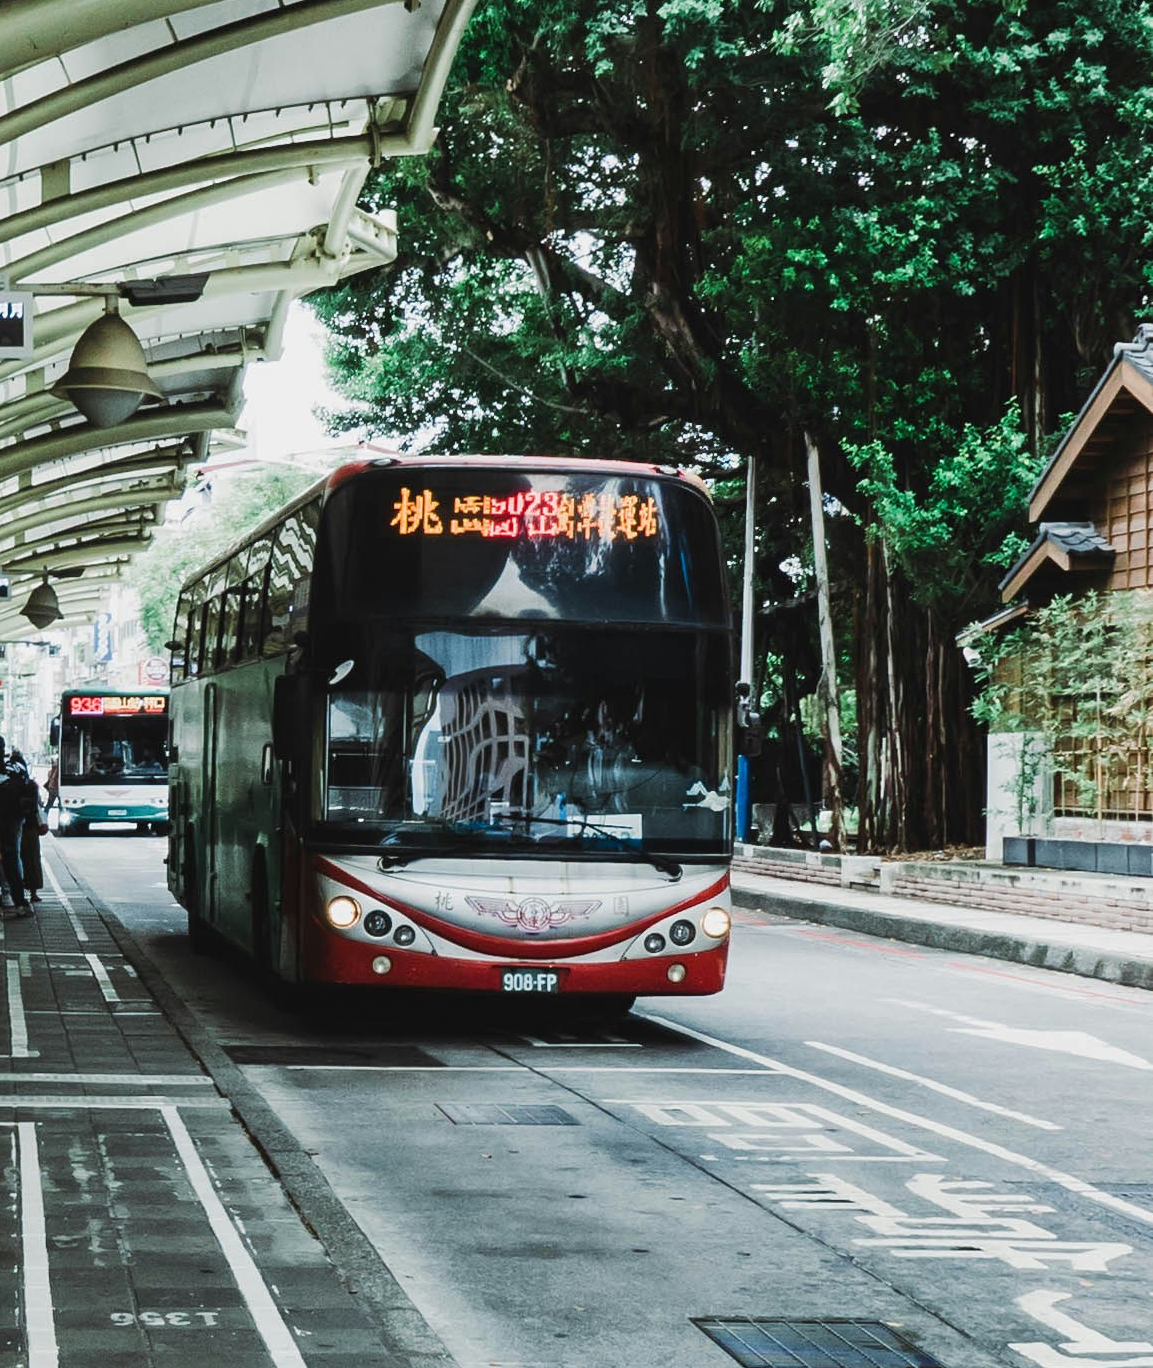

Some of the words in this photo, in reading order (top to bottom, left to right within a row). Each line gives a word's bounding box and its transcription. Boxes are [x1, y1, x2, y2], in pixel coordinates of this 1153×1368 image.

[70, 697, 102, 712] 936
[503, 973, 558, 992] 908-FP
[110, 1310, 220, 1327] 1356
